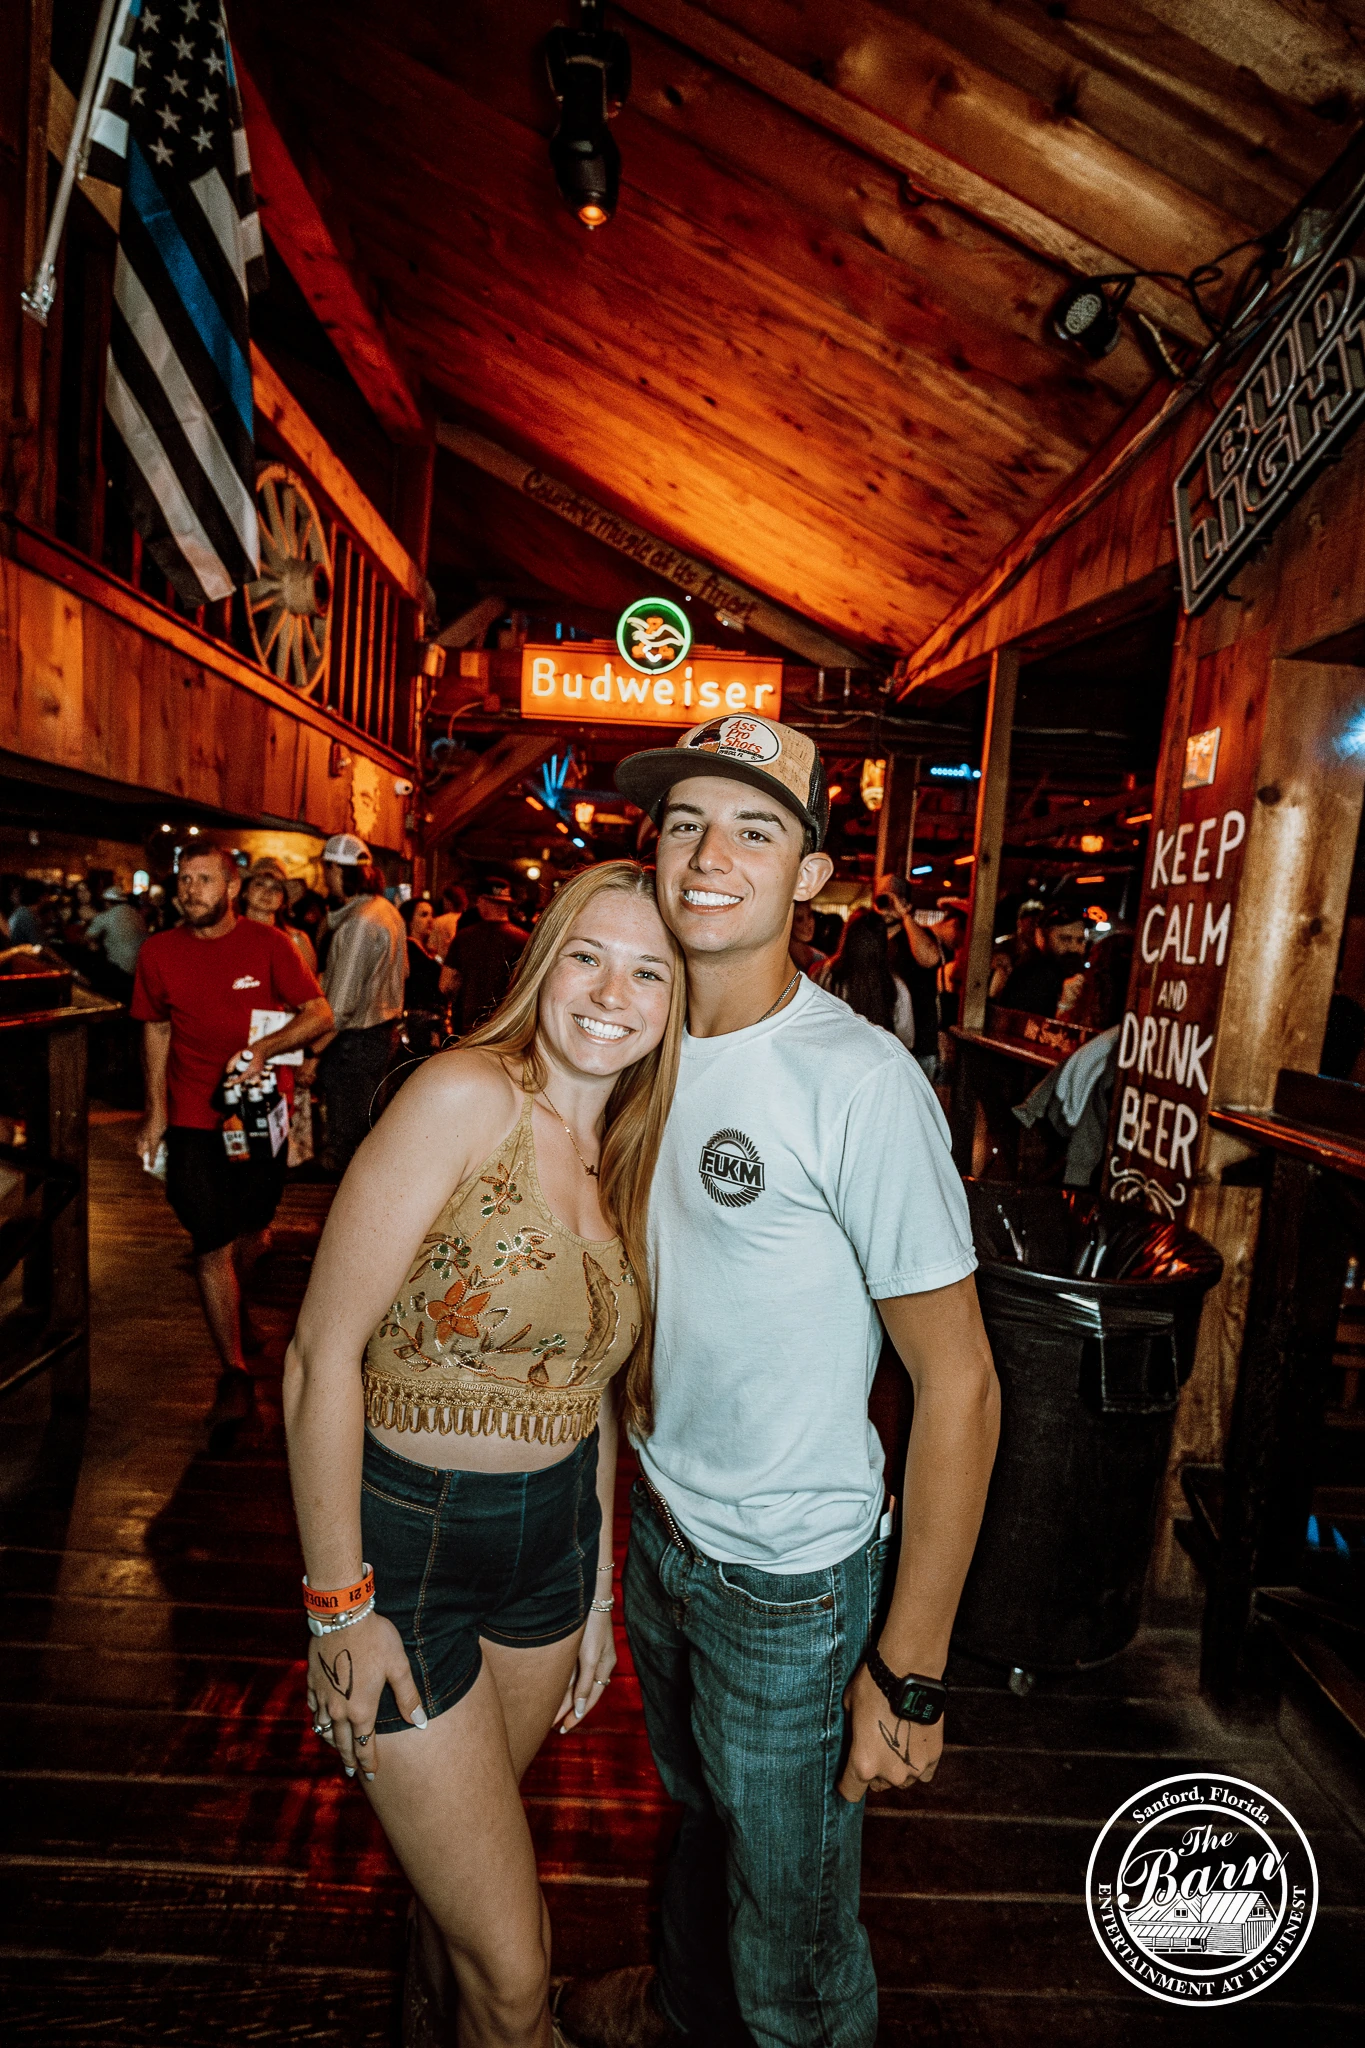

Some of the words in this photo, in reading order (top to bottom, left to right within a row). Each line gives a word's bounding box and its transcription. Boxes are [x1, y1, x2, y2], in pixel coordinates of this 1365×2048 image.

[1205, 256, 1357, 500] BUD
[650, 549, 675, 571] at
[697, 573, 759, 624] finest
[531, 656, 775, 710] Budweiser
[721, 736, 763, 755] Shots
[725, 728, 751, 740] Pro
[727, 719, 757, 732] Ass
[1150, 810, 1246, 891] KEEP
[1140, 901, 1231, 967] CALM
[1157, 978, 1188, 1012] AND
[1117, 1011, 1213, 1096] DRINK
[1116, 1086, 1199, 1180] BEER
[348, 1587, 362, 1603] 21
